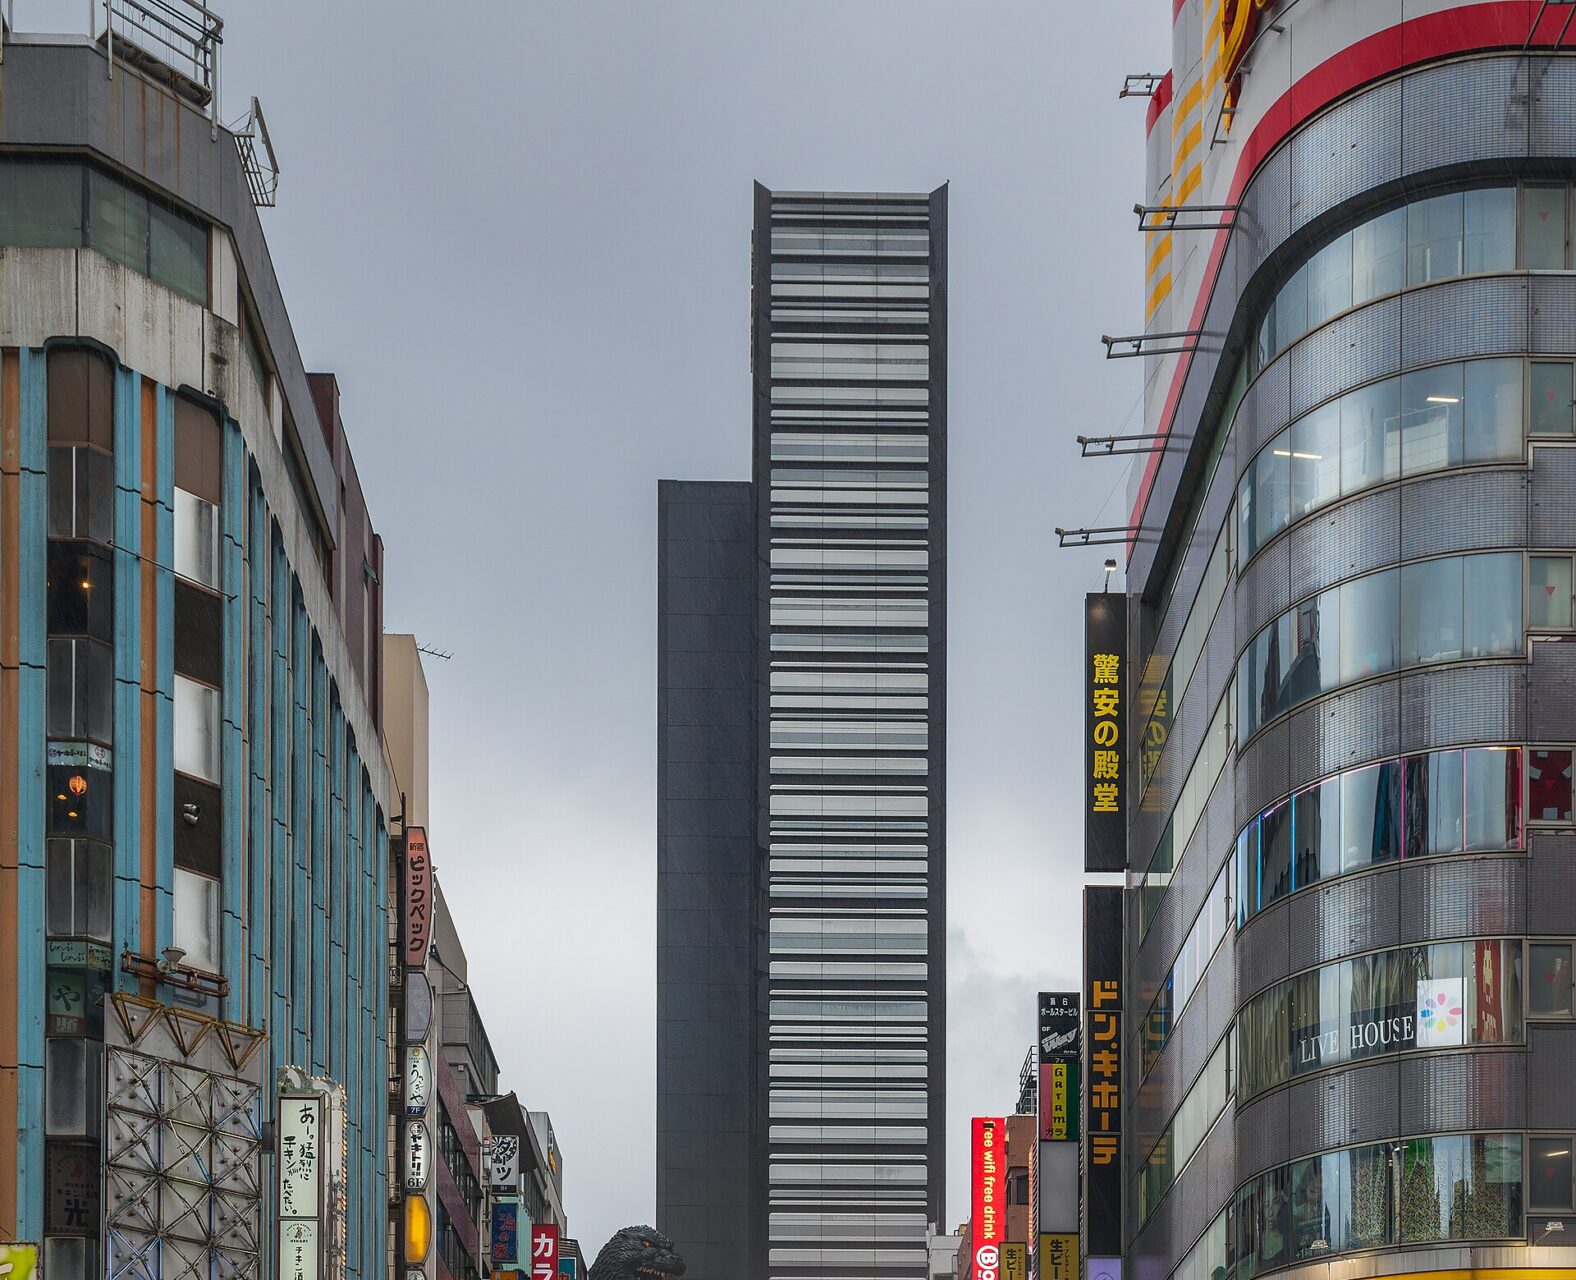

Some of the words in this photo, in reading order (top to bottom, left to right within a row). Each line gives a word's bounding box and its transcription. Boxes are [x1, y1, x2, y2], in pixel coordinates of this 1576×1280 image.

[1092, 653, 1119, 812] 驚安の殿堂
[1300, 1030, 1338, 1064] LIVE
[1350, 1016, 1414, 1050] HOUSE
[1092, 981, 1119, 1164] ドン・キホーテ
[1053, 1067, 1065, 1124] Garam
[983, 1120, 994, 1148] free
[983, 1150, 995, 1173] wifi
[408, 1177, 424, 1188] 6F
[983, 1175, 994, 1198] free
[983, 1199, 994, 1239] drink
